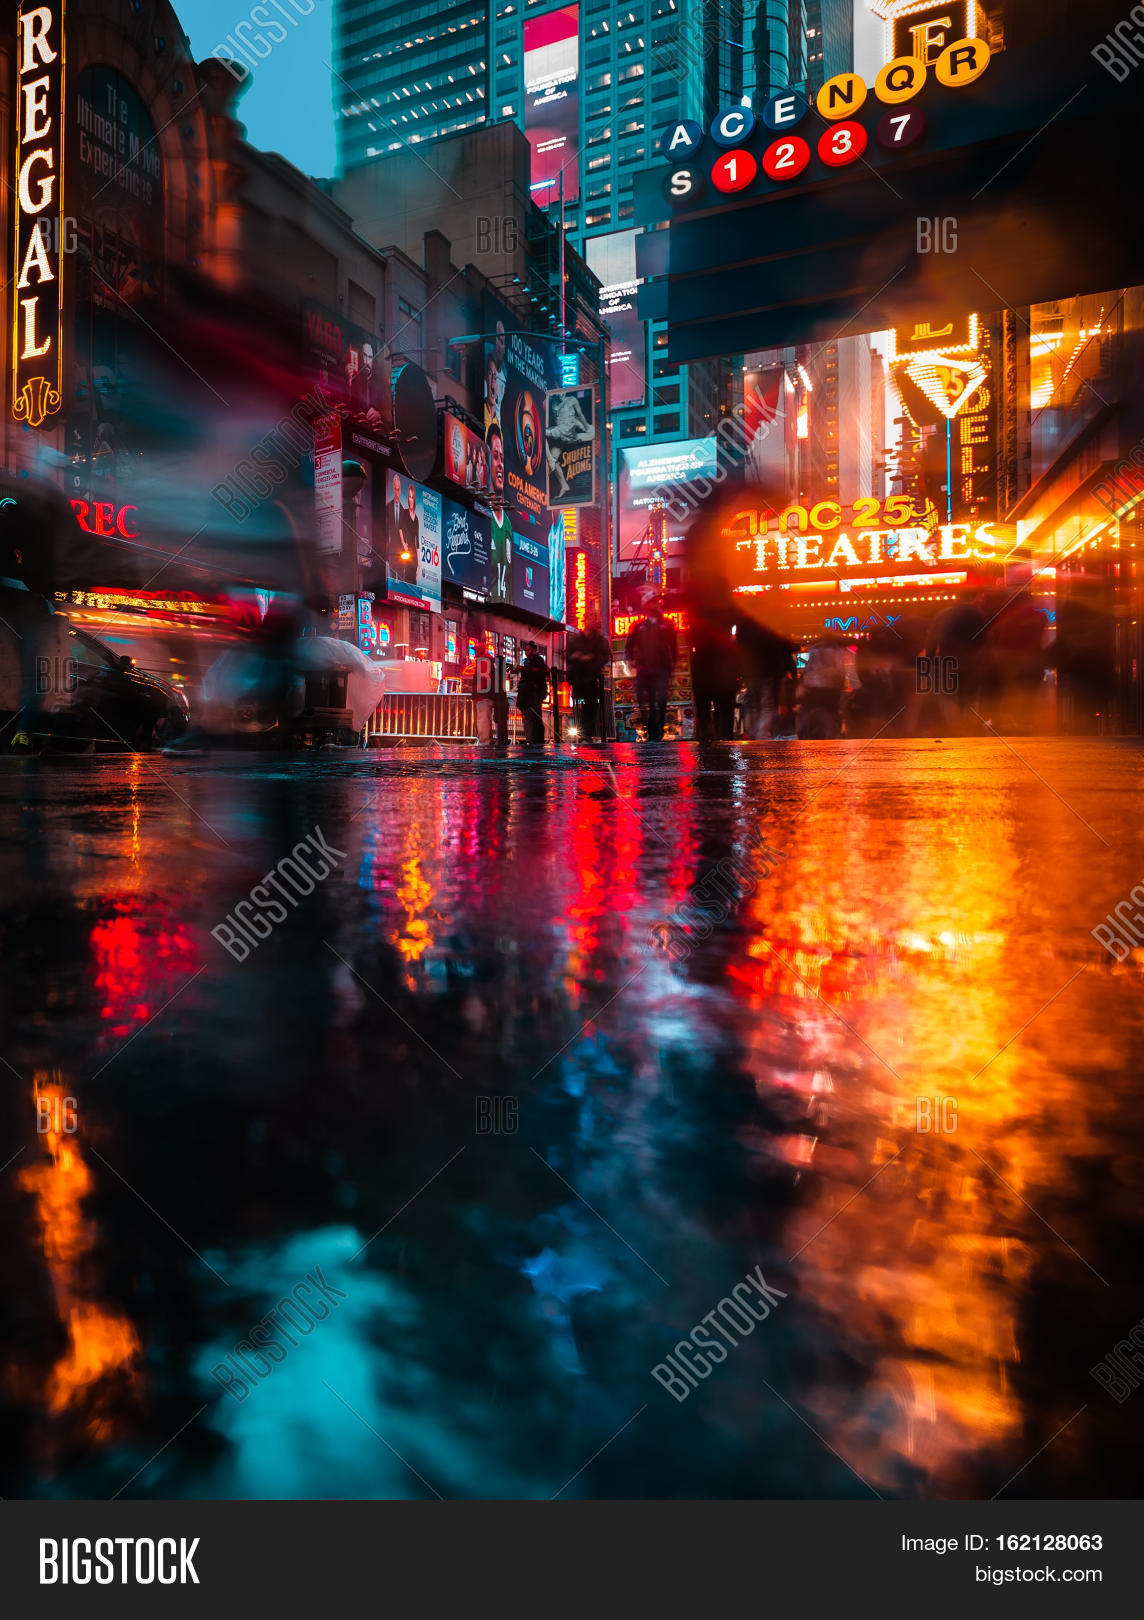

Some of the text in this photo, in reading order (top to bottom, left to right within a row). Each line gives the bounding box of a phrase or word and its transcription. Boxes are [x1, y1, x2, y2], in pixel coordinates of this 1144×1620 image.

[533, 91, 567, 106] AMERICA
[545, 87, 556, 95] OF
[669, 44, 979, 150] A C E N Q R
[670, 114, 911, 196] S 1 2 3 7
[17, 6, 57, 360] REGAL
[599, 288, 638, 300] UNDATIO
[609, 298, 620, 306] OF
[507, 348, 548, 394] IN THE MAKING
[511, 334, 545, 375] 100 YEARS
[561, 445, 592, 468] SHUFFLE
[566, 459, 592, 481] ALONG
[507, 471, 549, 506] COPA AMERICA
[721, 495, 911, 537] amc 25
[421, 545, 440, 567] 2016
[519, 539, 530, 553] JUNE
[735, 522, 996, 572] THEATRES
[497, 563, 507, 599] 14
